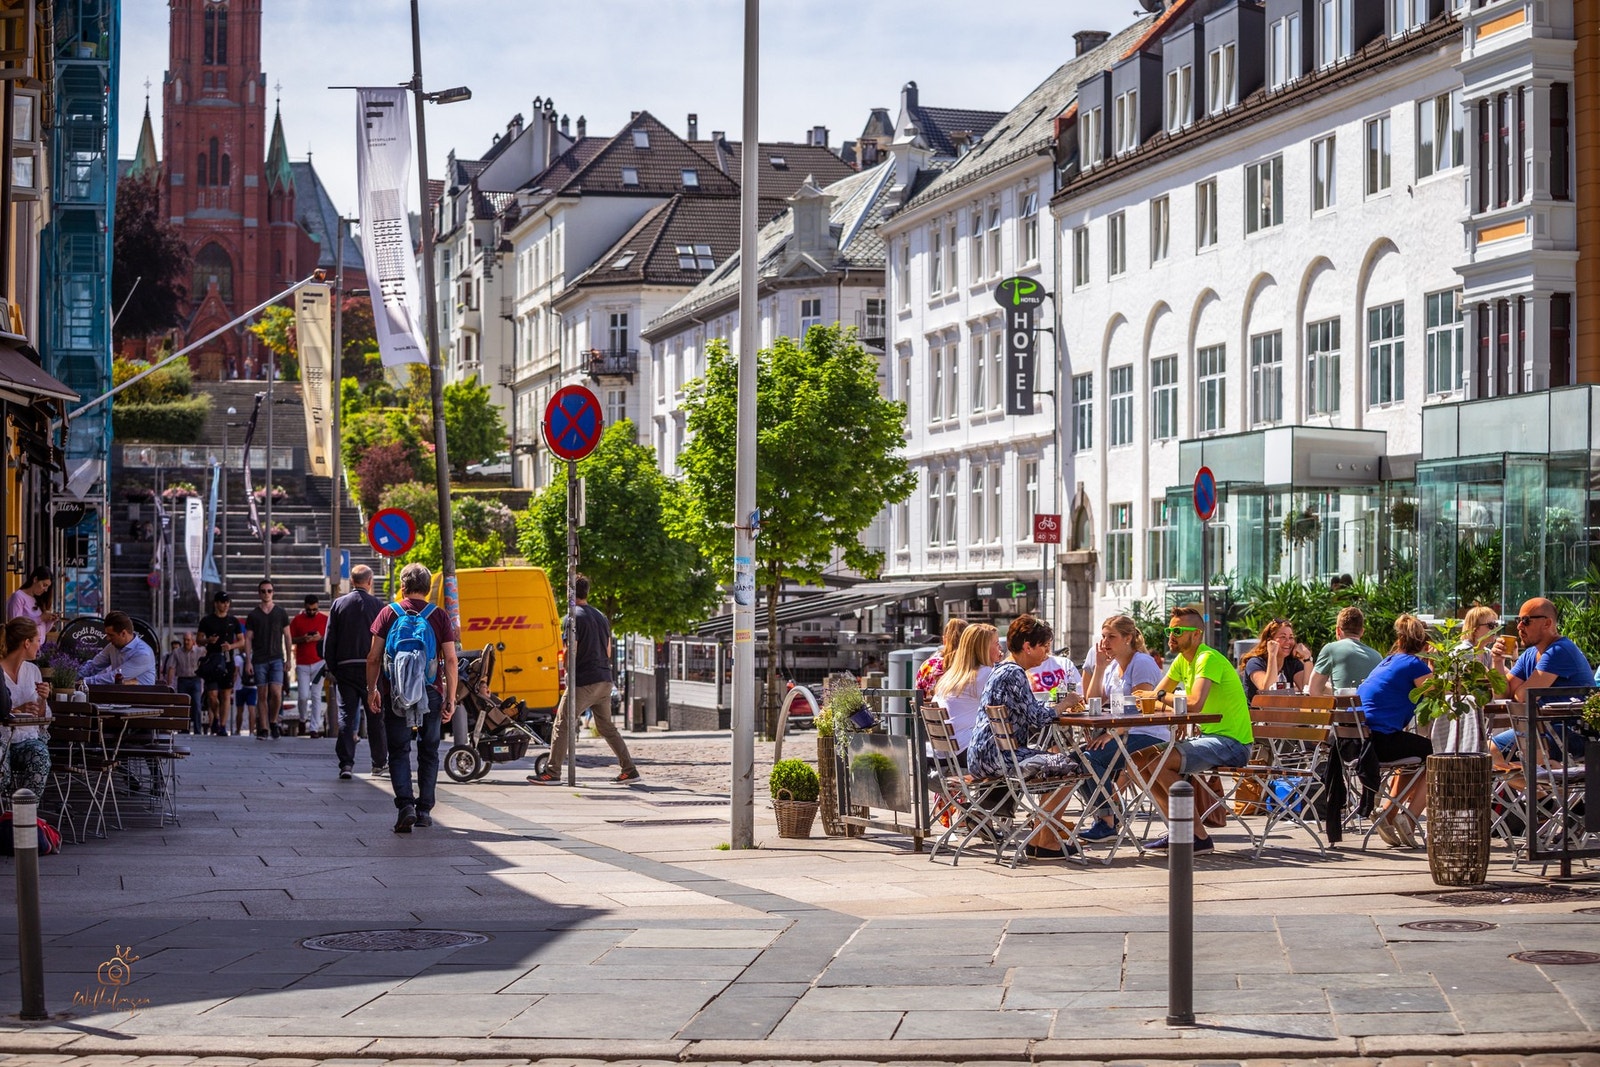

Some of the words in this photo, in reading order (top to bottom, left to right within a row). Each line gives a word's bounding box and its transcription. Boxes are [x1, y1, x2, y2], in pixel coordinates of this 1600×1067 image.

[1013, 312, 1029, 410] HOTEL
[467, 615, 531, 631] DHL
[72, 626, 89, 639] Godt
